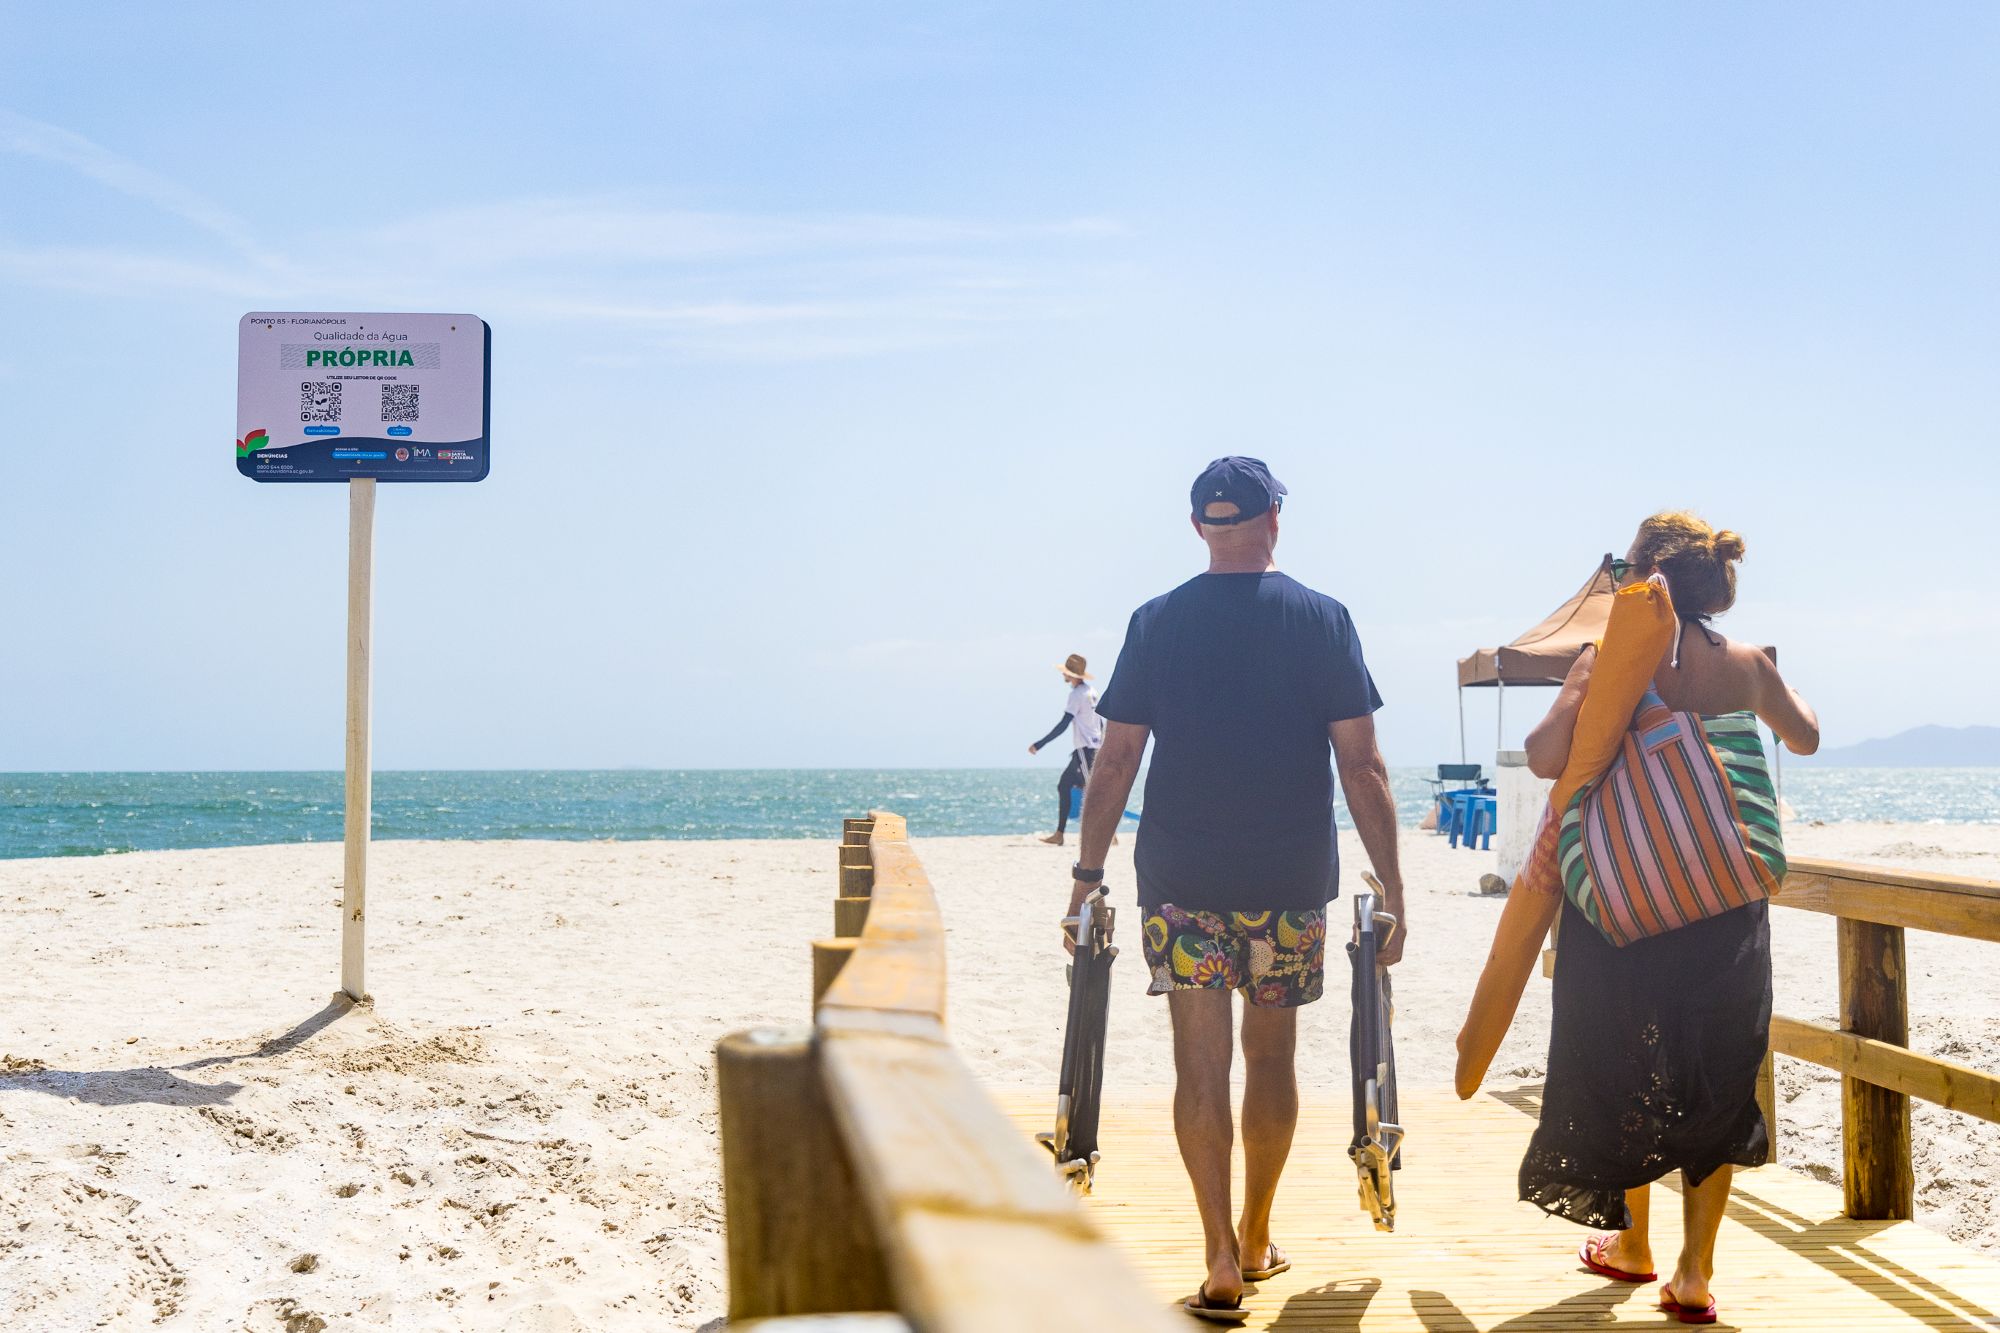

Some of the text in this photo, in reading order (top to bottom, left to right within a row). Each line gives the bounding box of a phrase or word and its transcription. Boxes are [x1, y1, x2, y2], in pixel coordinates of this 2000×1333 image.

[313, 330, 408, 343] Qualidade da Água
[306, 346, 415, 367] PRÓPRIA
